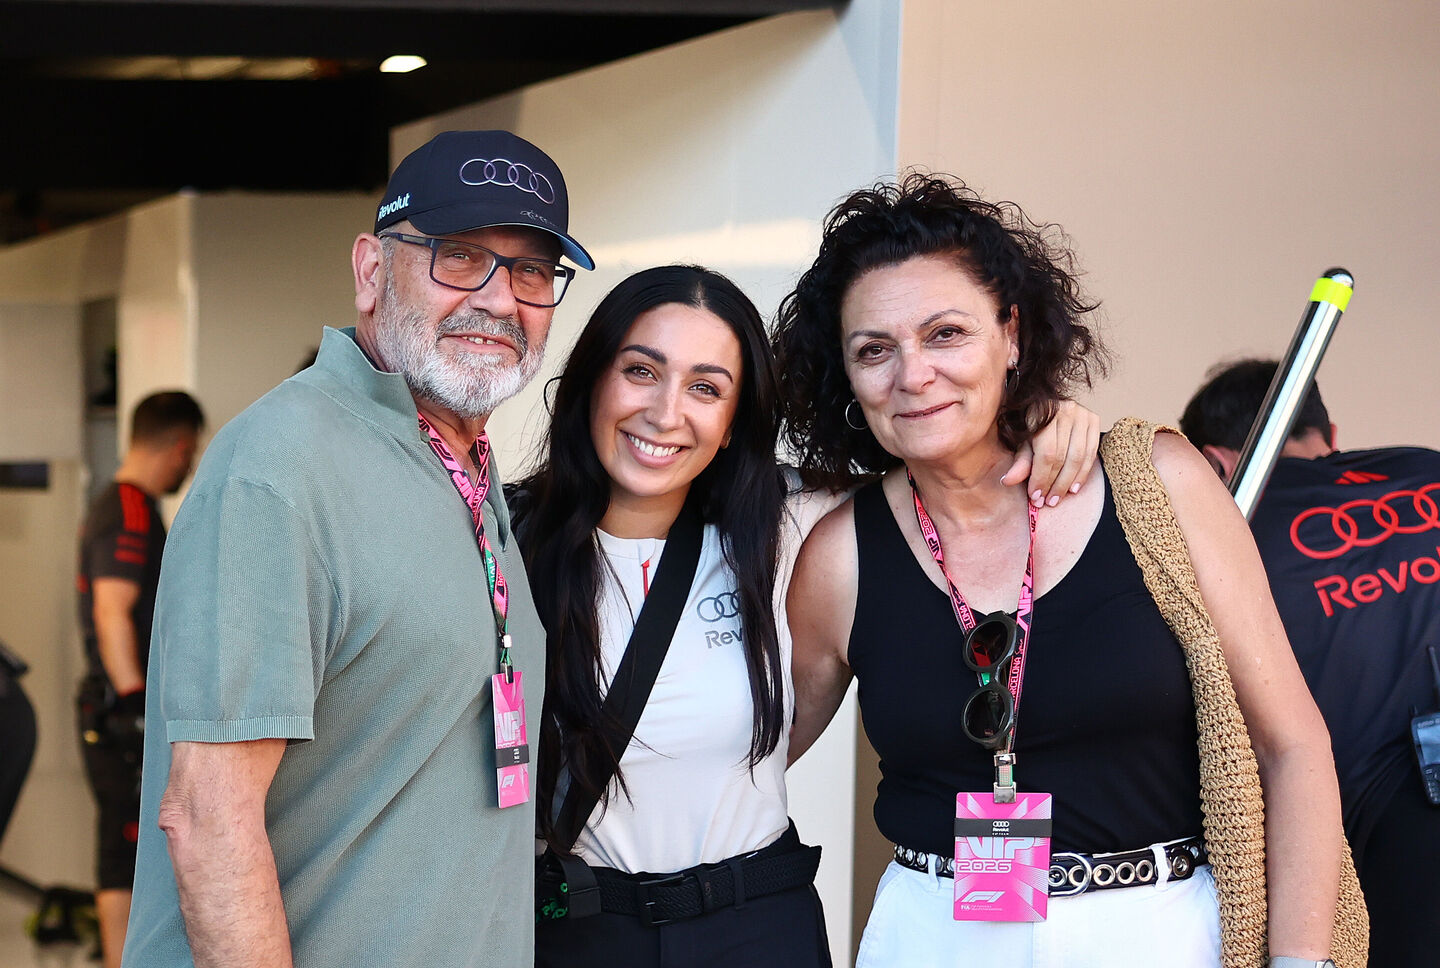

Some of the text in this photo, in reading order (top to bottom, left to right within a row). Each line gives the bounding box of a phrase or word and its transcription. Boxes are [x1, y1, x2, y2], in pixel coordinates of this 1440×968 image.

[378, 192, 410, 222] Revolut
[1313, 546, 1440, 617] Revo
[704, 627, 742, 649] Rev
[965, 836, 1035, 859] VIP
[957, 859, 1013, 874] 2026
